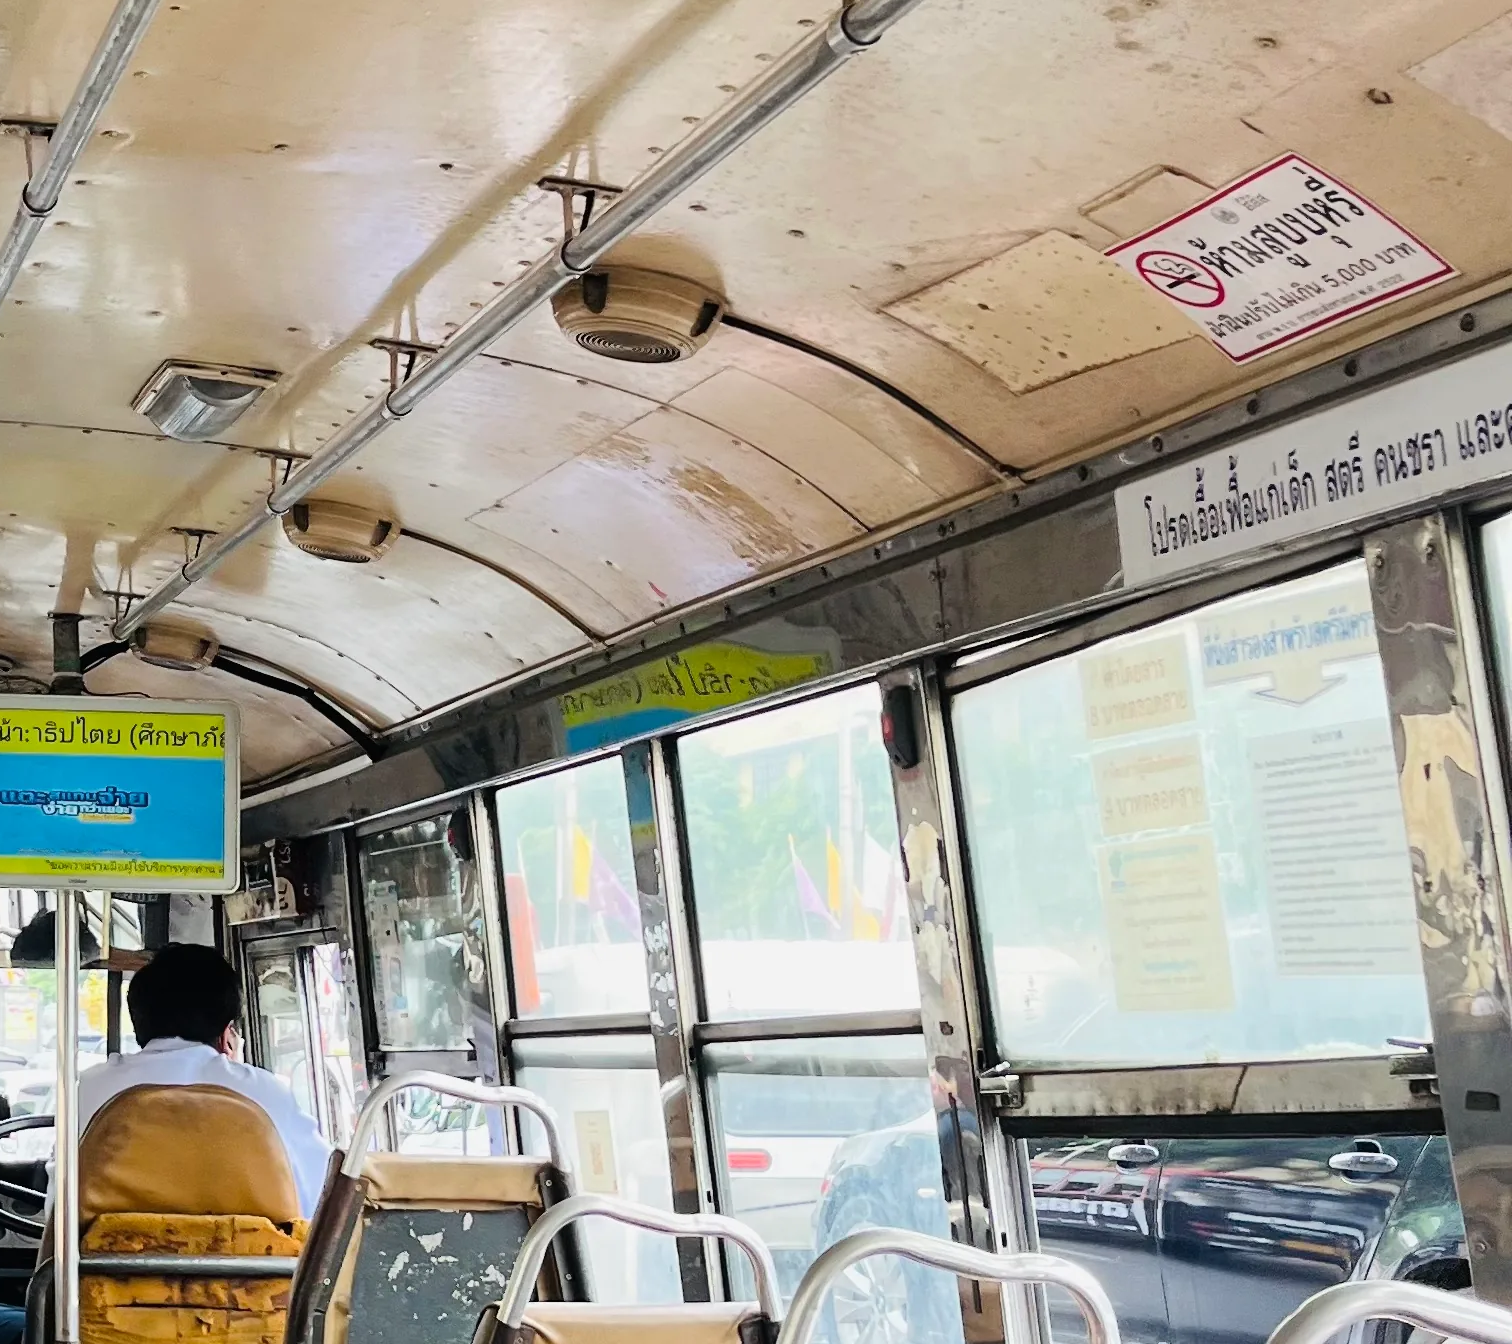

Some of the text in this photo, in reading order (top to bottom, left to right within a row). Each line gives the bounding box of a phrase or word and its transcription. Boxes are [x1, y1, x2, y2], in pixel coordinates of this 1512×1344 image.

[1188, 166, 1364, 278] ห้ามสูบบุหรี่
[1321, 258, 1378, 288] 5,000
[1375, 242, 1417, 264] บาท
[1324, 430, 1365, 503] สตรี
[1375, 428, 1448, 488] คนชรา
